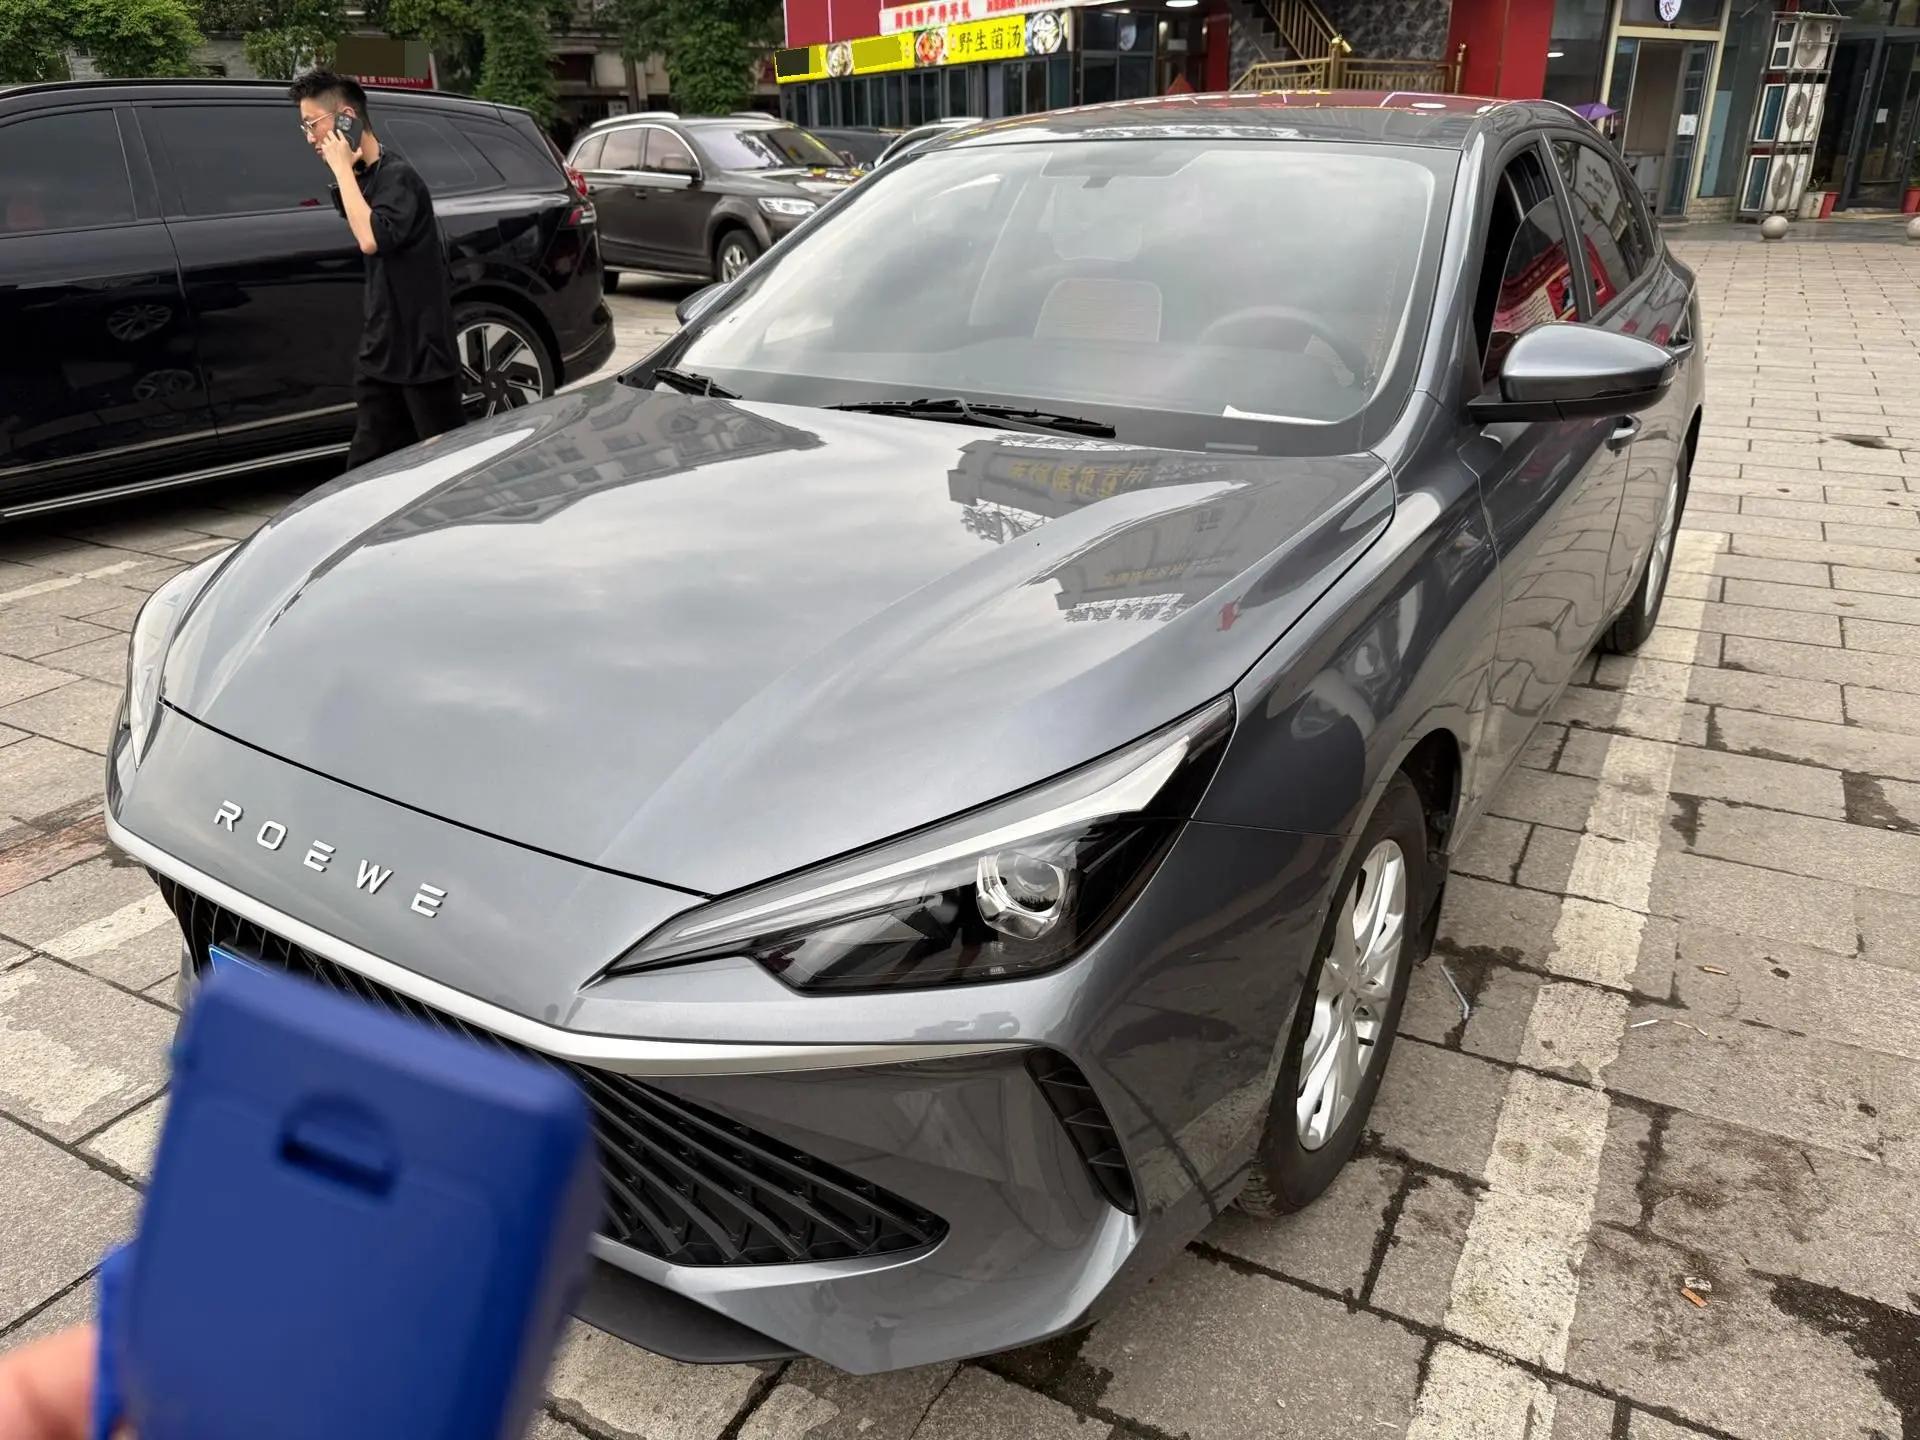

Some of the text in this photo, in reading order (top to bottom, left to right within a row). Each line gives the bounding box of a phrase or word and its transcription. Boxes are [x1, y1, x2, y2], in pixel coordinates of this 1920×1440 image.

[959, 24, 1021, 54] 野生菌汤
[213, 799, 448, 919] ROEWE
